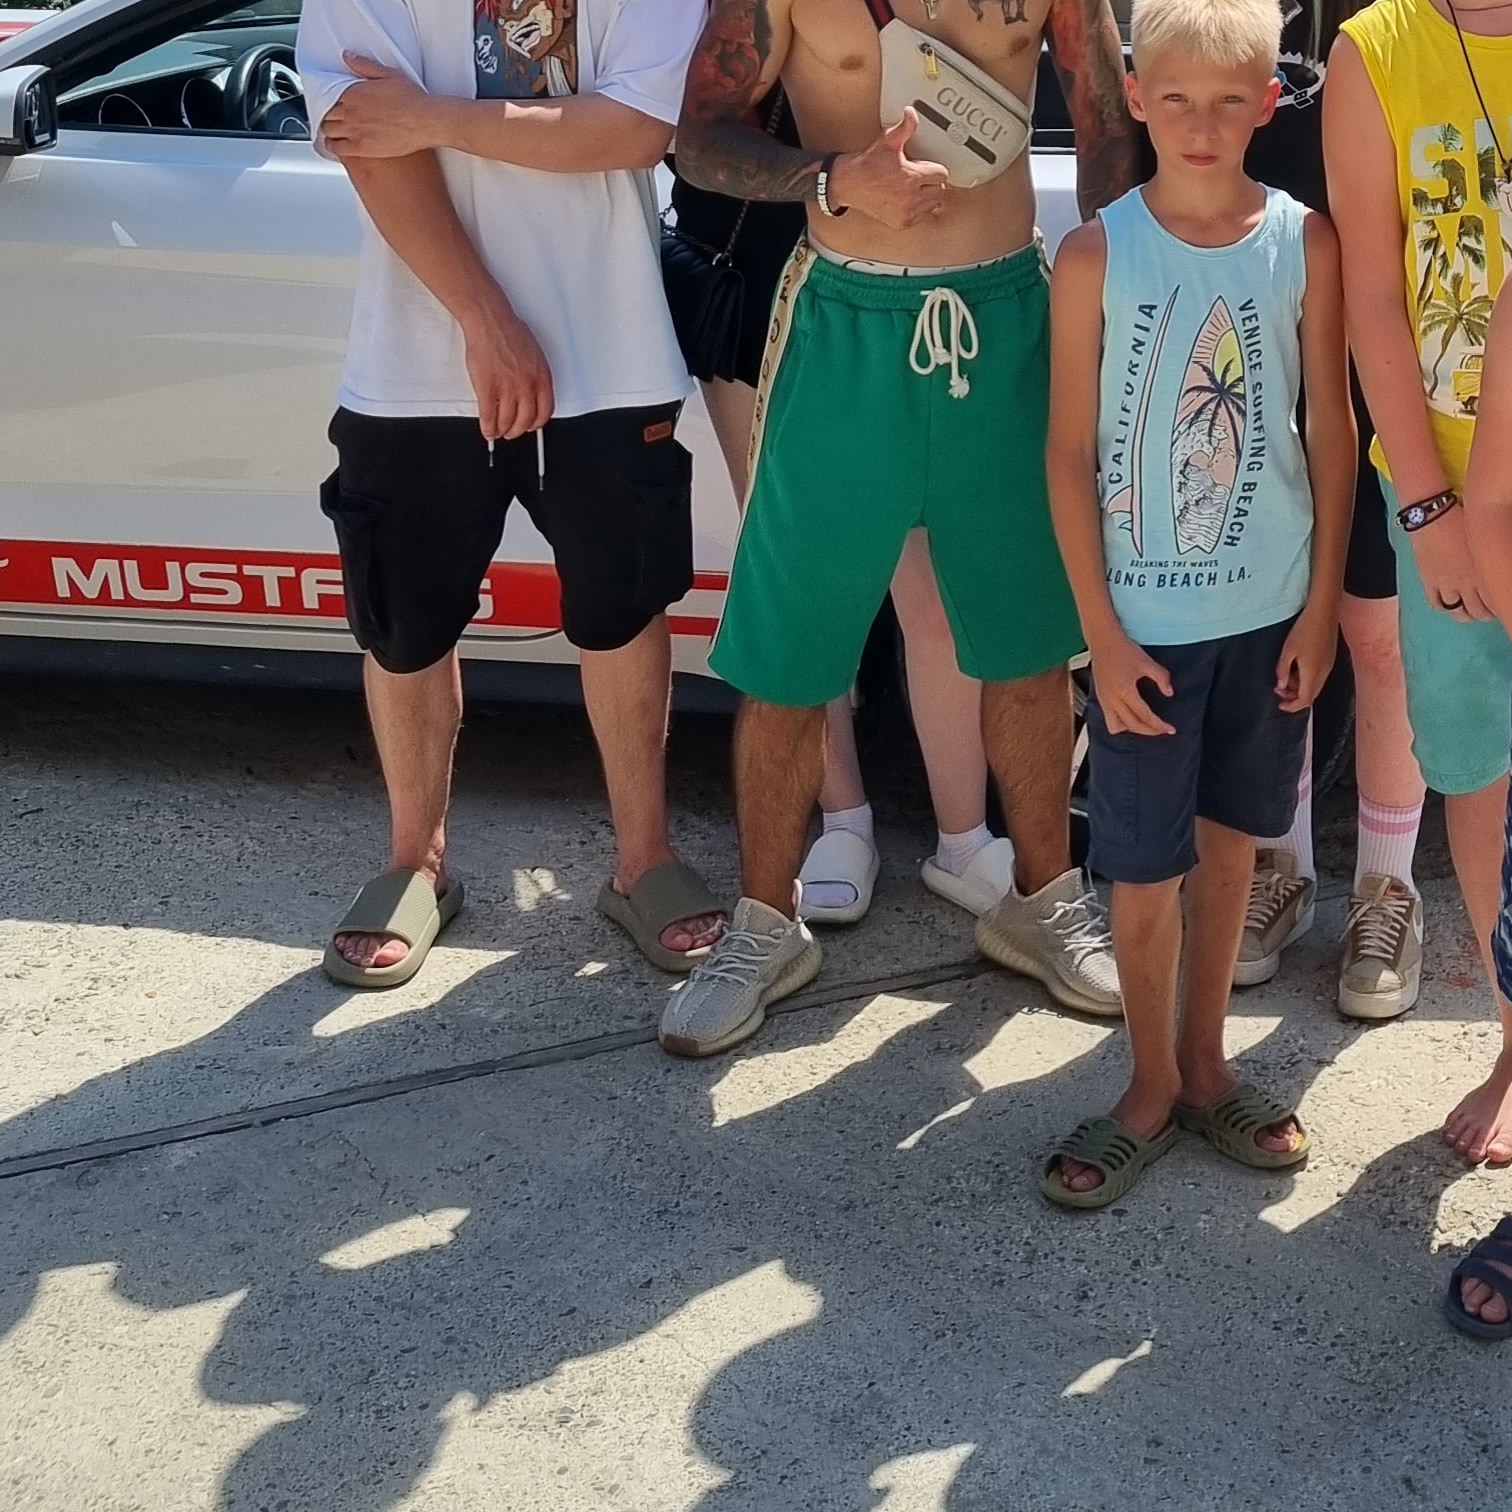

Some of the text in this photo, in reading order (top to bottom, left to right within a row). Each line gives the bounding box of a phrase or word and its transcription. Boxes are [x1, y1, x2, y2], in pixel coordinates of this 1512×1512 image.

[936, 86, 1005, 141] GUCCI
[1108, 303, 1158, 485] CALIFORNIA
[1223, 298, 1267, 547] VENICE SURFING BEACH
[51, 556, 494, 620] MUSTA
[1106, 566, 1252, 588] LONG BEACH LA.
[1190, 559, 1219, 568] WAVES
